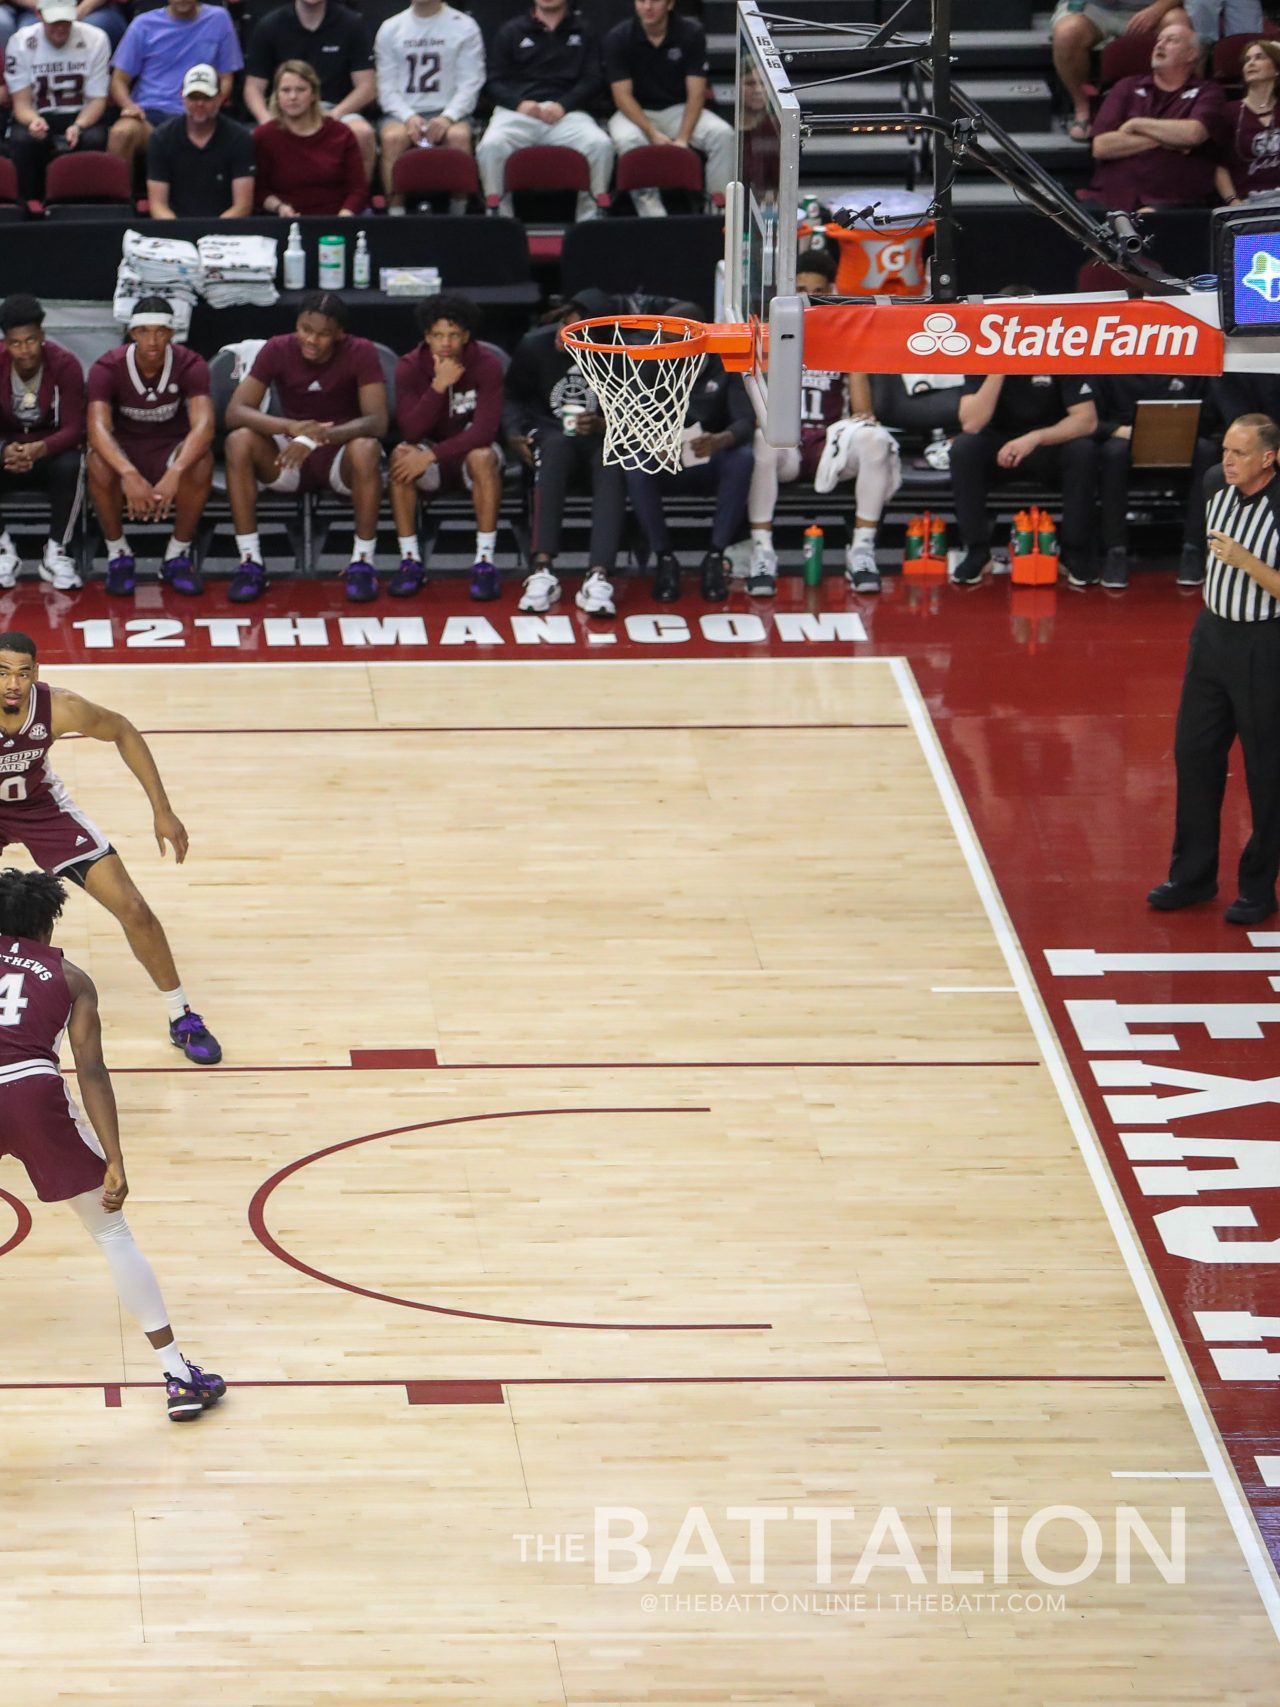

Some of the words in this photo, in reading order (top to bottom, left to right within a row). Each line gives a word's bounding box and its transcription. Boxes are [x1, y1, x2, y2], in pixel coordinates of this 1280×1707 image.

[406, 52, 441, 93] 12
[32, 75, 85, 107] 12
[881, 244, 905, 271] G
[72, 611, 869, 648] 12THMAN.COM
